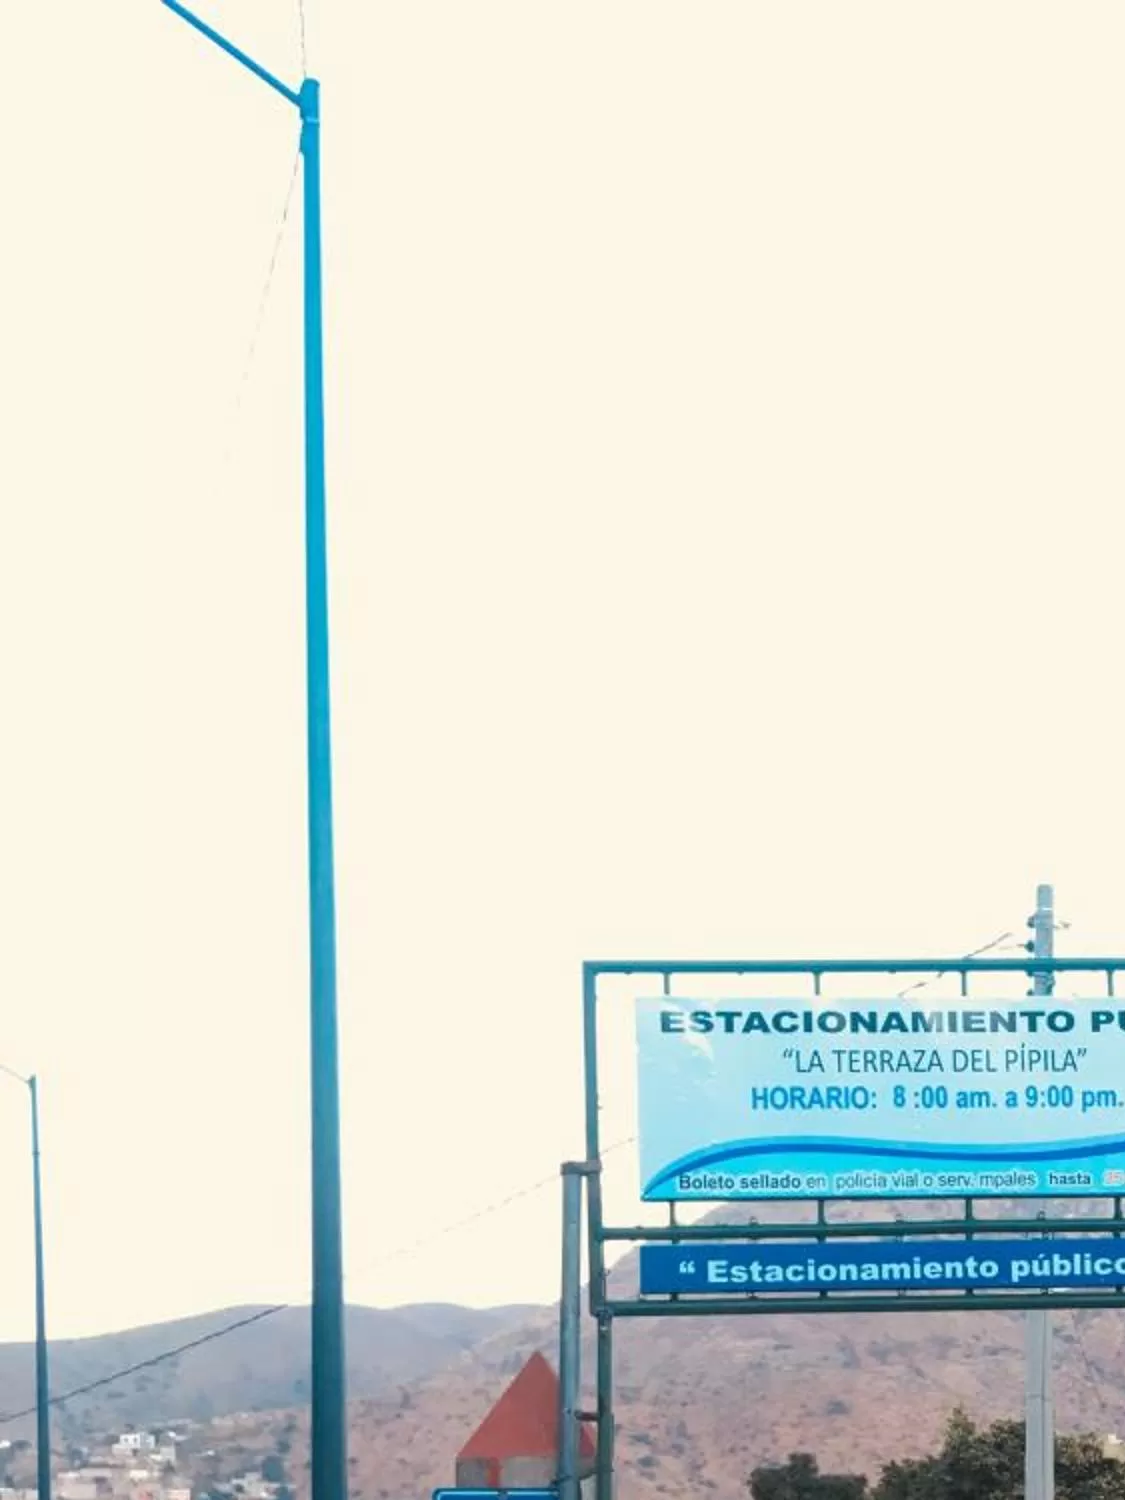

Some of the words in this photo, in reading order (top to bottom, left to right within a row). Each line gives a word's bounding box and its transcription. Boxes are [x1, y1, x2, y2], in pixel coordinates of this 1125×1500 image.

[659, 1009, 1075, 1034] ESTACIONAMIENTO
[832, 1049, 945, 1073] TERRAZA
[952, 1049, 997, 1073] DEL
[751, 1086, 877, 1110] HORARIO:
[956, 1090, 997, 1108] am.
[1005, 1090, 1018, 1108] a
[1025, 1085, 1073, 1108] 9:00
[1081, 1089, 1125, 1112] pm.
[679, 1174, 734, 1190] Boleto
[740, 1173, 800, 1190] sellado
[806, 1176, 826, 1189] en
[891, 1170, 919, 1188] vial
[923, 1175, 933, 1187] o
[1050, 1171, 1091, 1186] hasta
[707, 1255, 999, 1283] Estacionamiento
